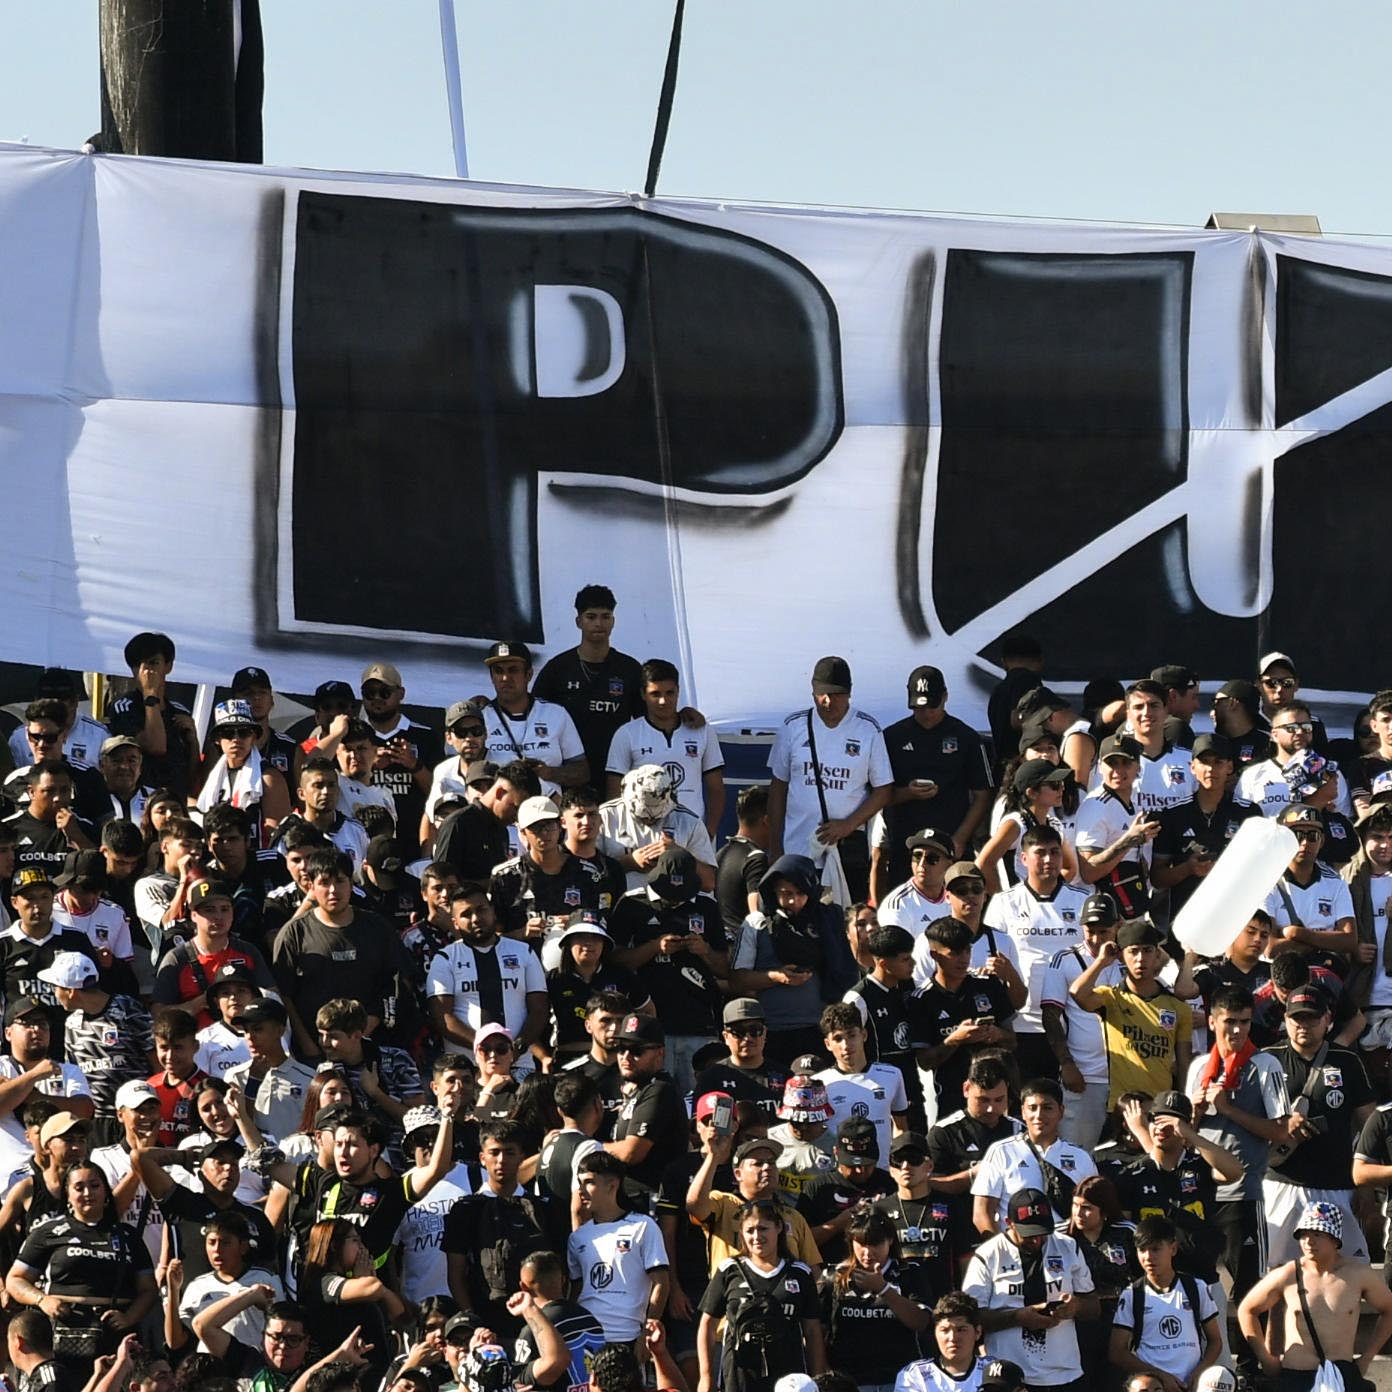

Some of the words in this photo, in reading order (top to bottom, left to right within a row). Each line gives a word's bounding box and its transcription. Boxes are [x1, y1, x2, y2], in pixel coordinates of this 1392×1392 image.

[373, 770, 412, 785] ilsen
[19, 852, 68, 862] COOLBET
[1017, 928, 1062, 937] COOLBET
[1122, 1024, 1170, 1047] Pilsen
[1137, 1041, 1170, 1060] Sur
[67, 1245, 118, 1259] COOLBET
[841, 1305, 884, 1319] COOLBET
[1158, 1314, 1183, 1340] MG
